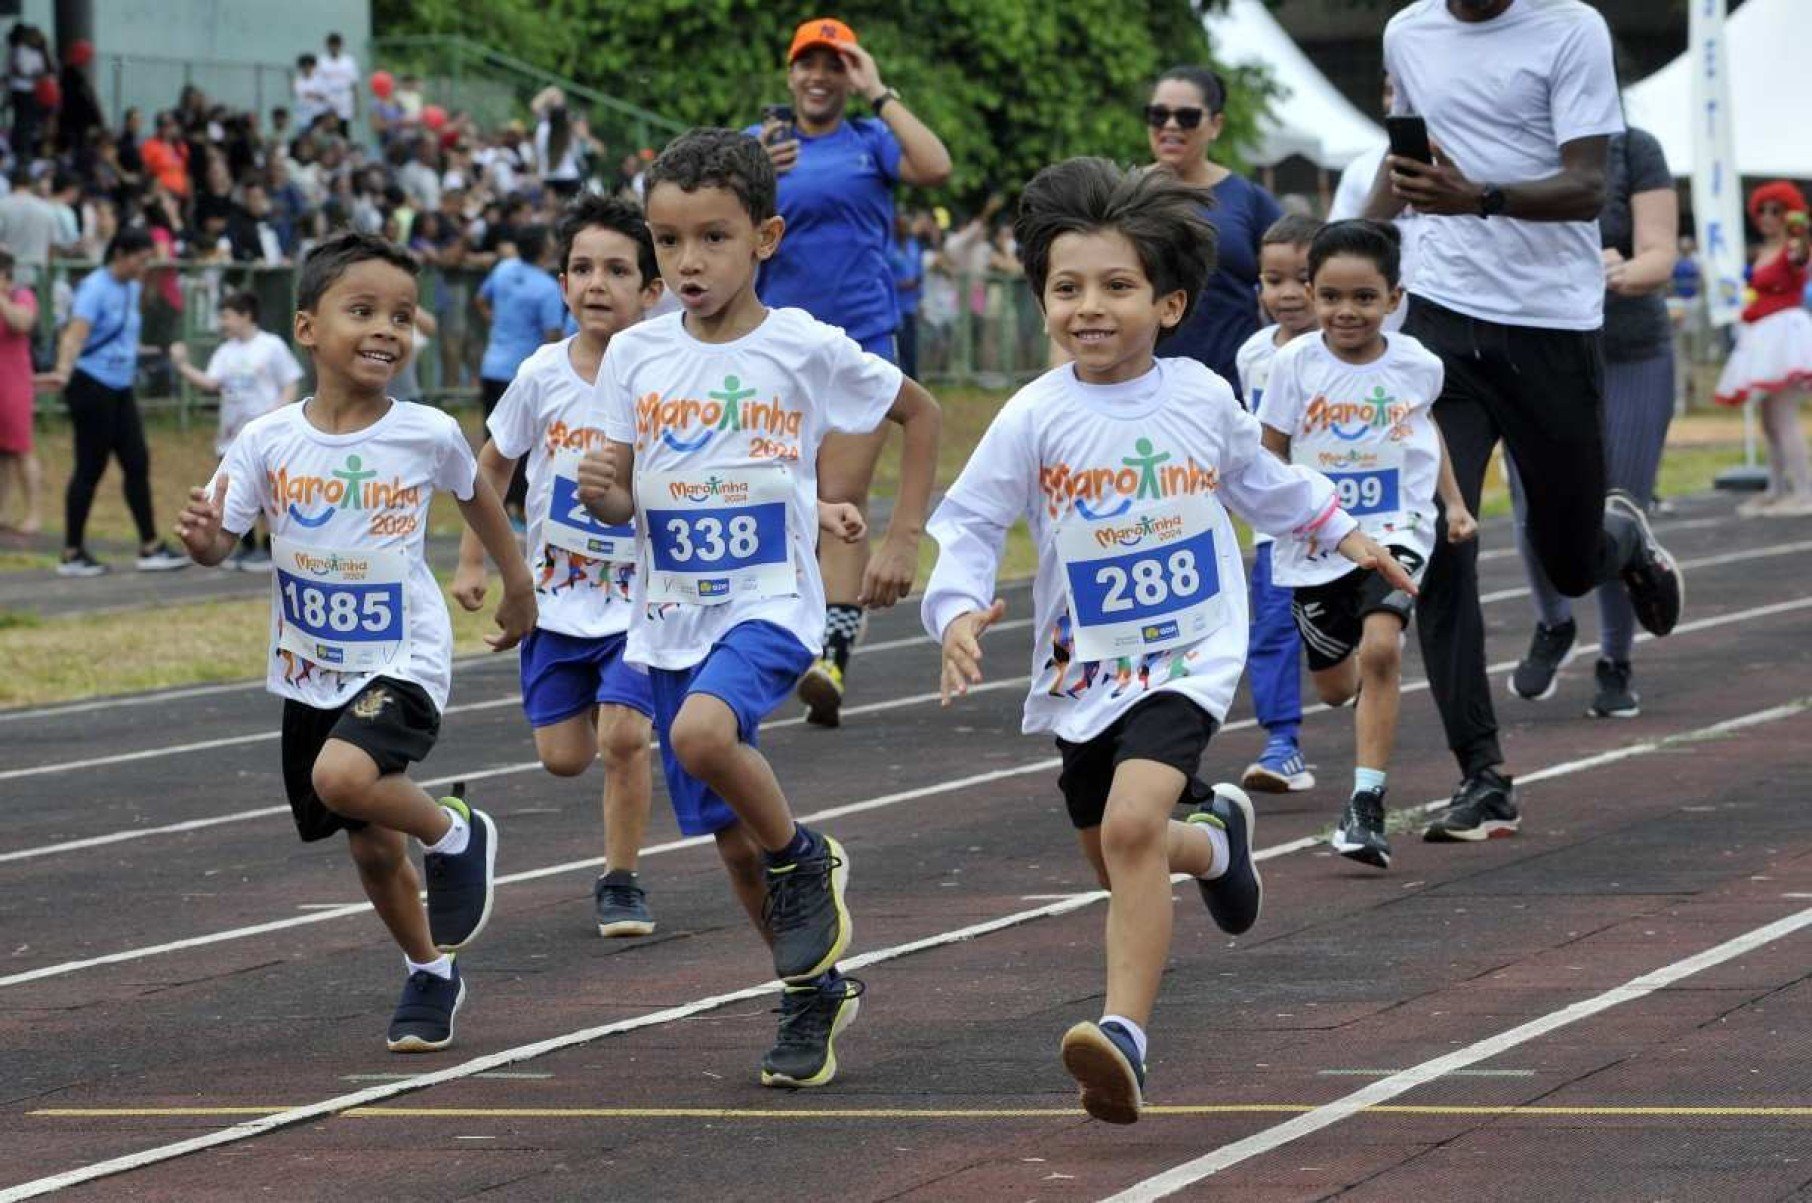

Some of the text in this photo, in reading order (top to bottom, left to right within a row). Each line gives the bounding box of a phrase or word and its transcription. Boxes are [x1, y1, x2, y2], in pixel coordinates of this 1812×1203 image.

[1339, 477, 1383, 509] 99
[667, 515, 759, 562] 338
[1096, 549, 1200, 613] 288
[286, 581, 392, 632] 1885
